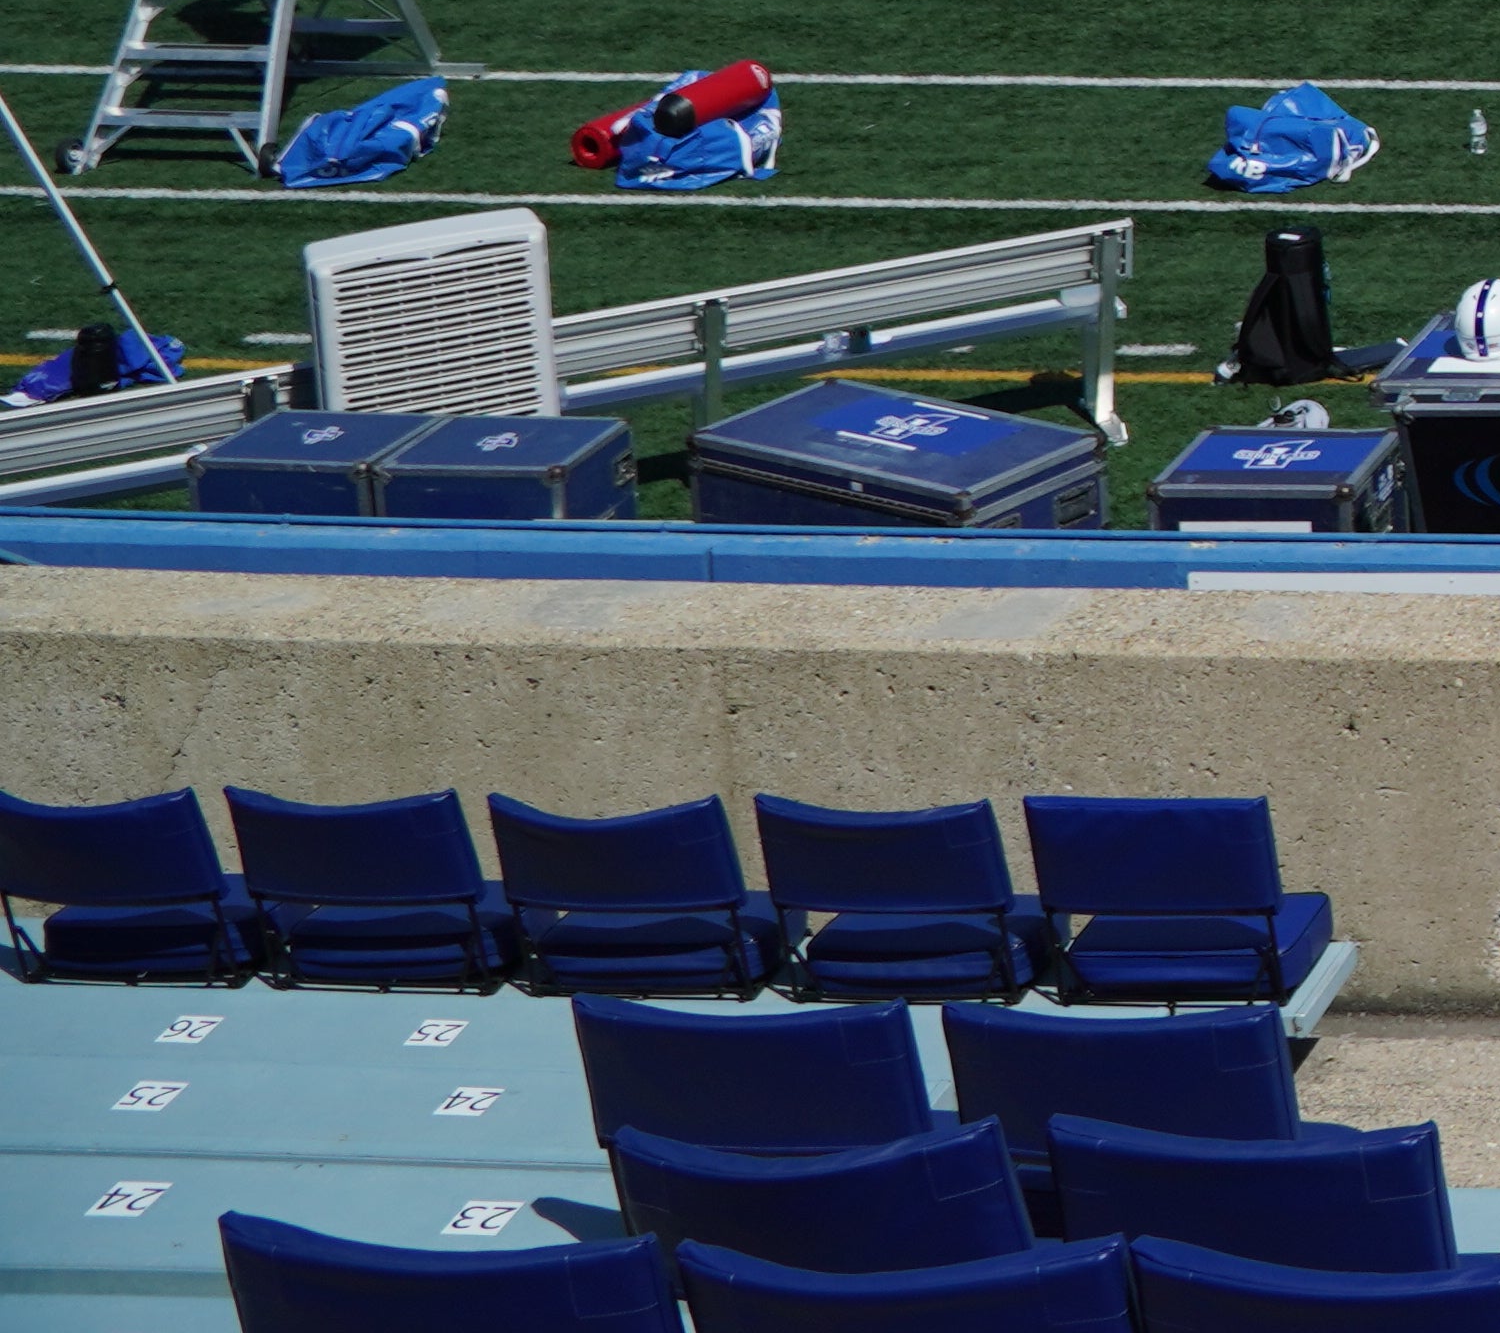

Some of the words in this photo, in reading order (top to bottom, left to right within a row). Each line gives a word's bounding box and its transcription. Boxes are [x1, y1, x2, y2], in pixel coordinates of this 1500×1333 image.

[163, 1020, 216, 1040] 26
[410, 1024, 464, 1043] 25
[120, 1085, 181, 1106] 25
[444, 1091, 502, 1111] 24
[97, 1186, 166, 1210] 24
[451, 1205, 520, 1229] 23
